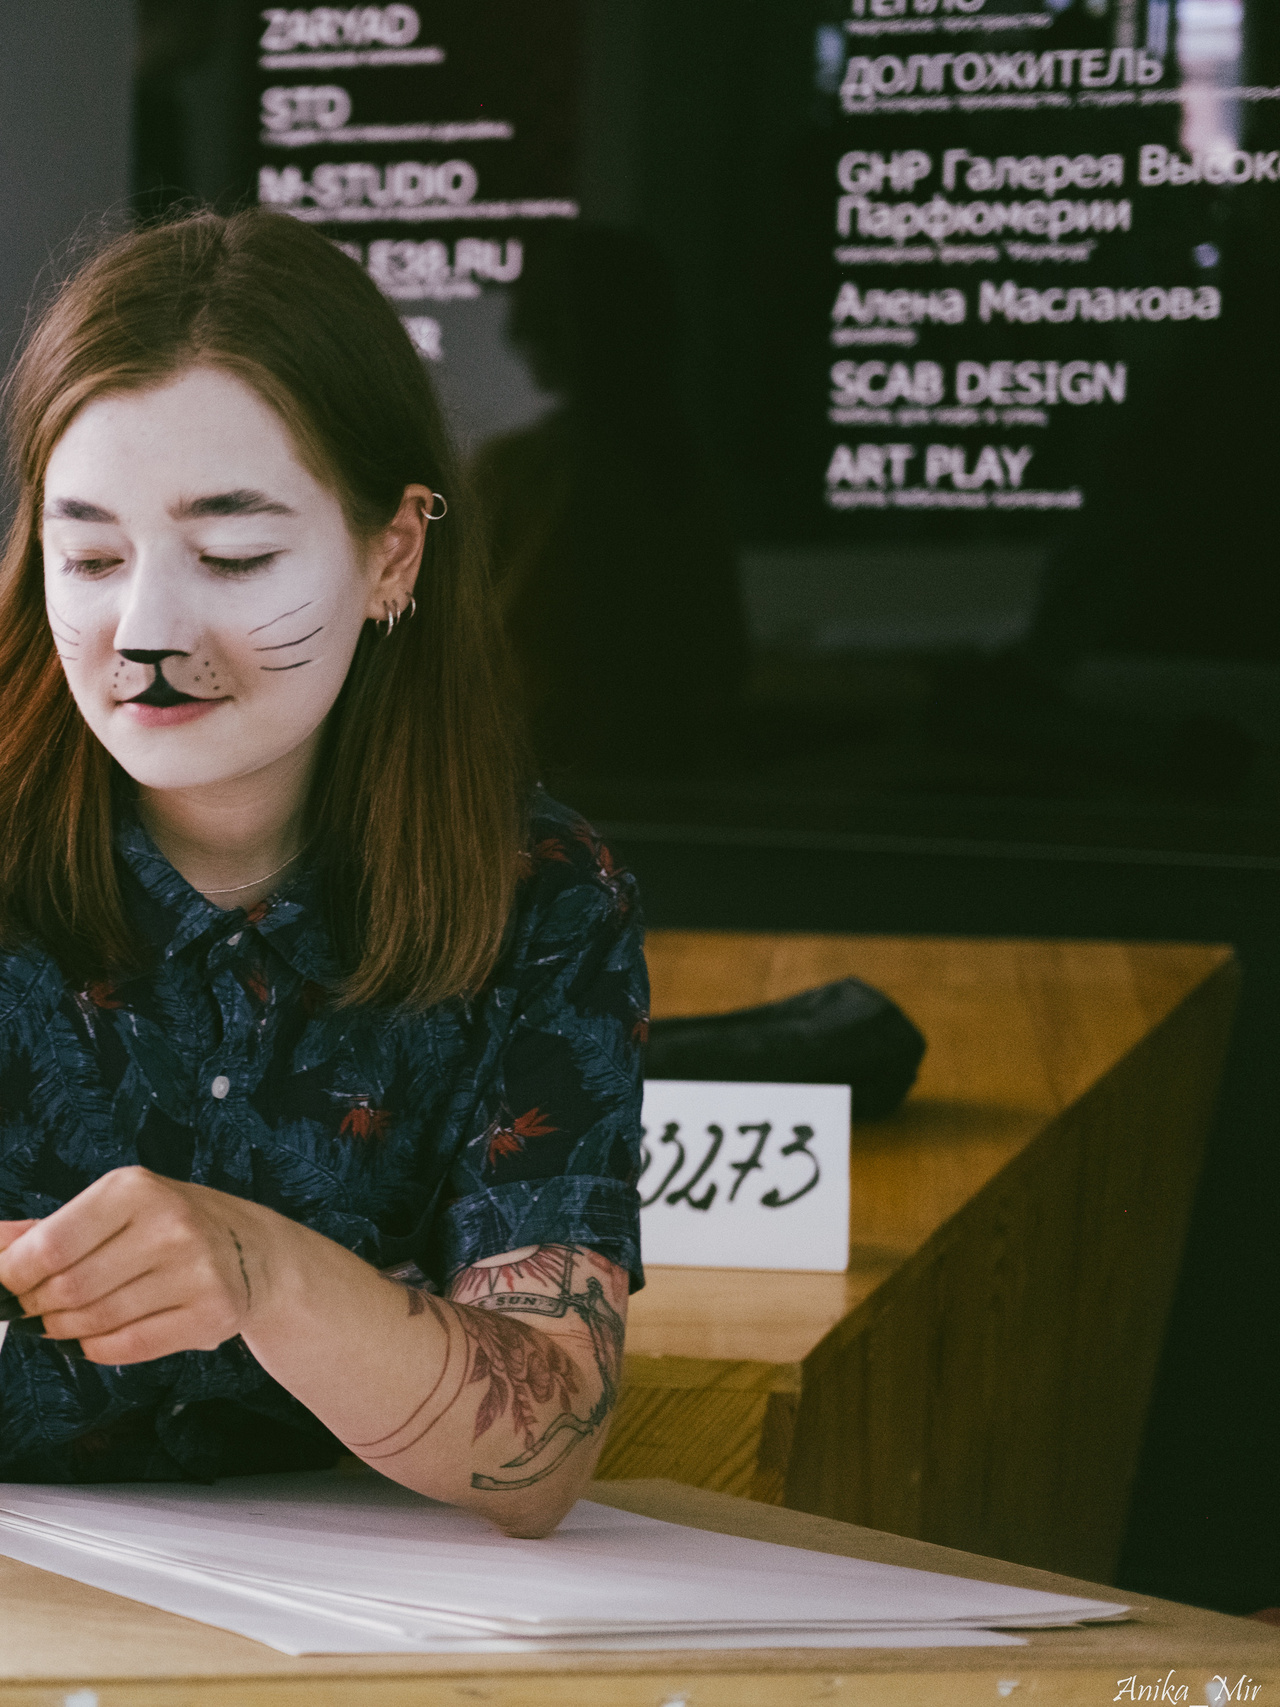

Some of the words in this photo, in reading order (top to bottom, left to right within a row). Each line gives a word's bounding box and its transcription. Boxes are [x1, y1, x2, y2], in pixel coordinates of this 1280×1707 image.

[841, 49, 1163, 102] ДОЛГОЖИТЕЛЬ
[261, 86, 351, 130] STD
[259, 161, 477, 206] M-STUDIO
[943, 149, 1124, 197] Галерея
[1139, 145, 1280, 186] Высок
[837, 194, 1131, 246] Парфюмерии
[832, 282, 965, 325] Алена
[978, 280, 1220, 323] Маслакова
[830, 361, 943, 405] SCAB
[956, 360, 1126, 405] DESIGN
[827, 444, 914, 487] ART
[925, 445, 1032, 489] PLAY
[495, 1296, 537, 1306] SUN
